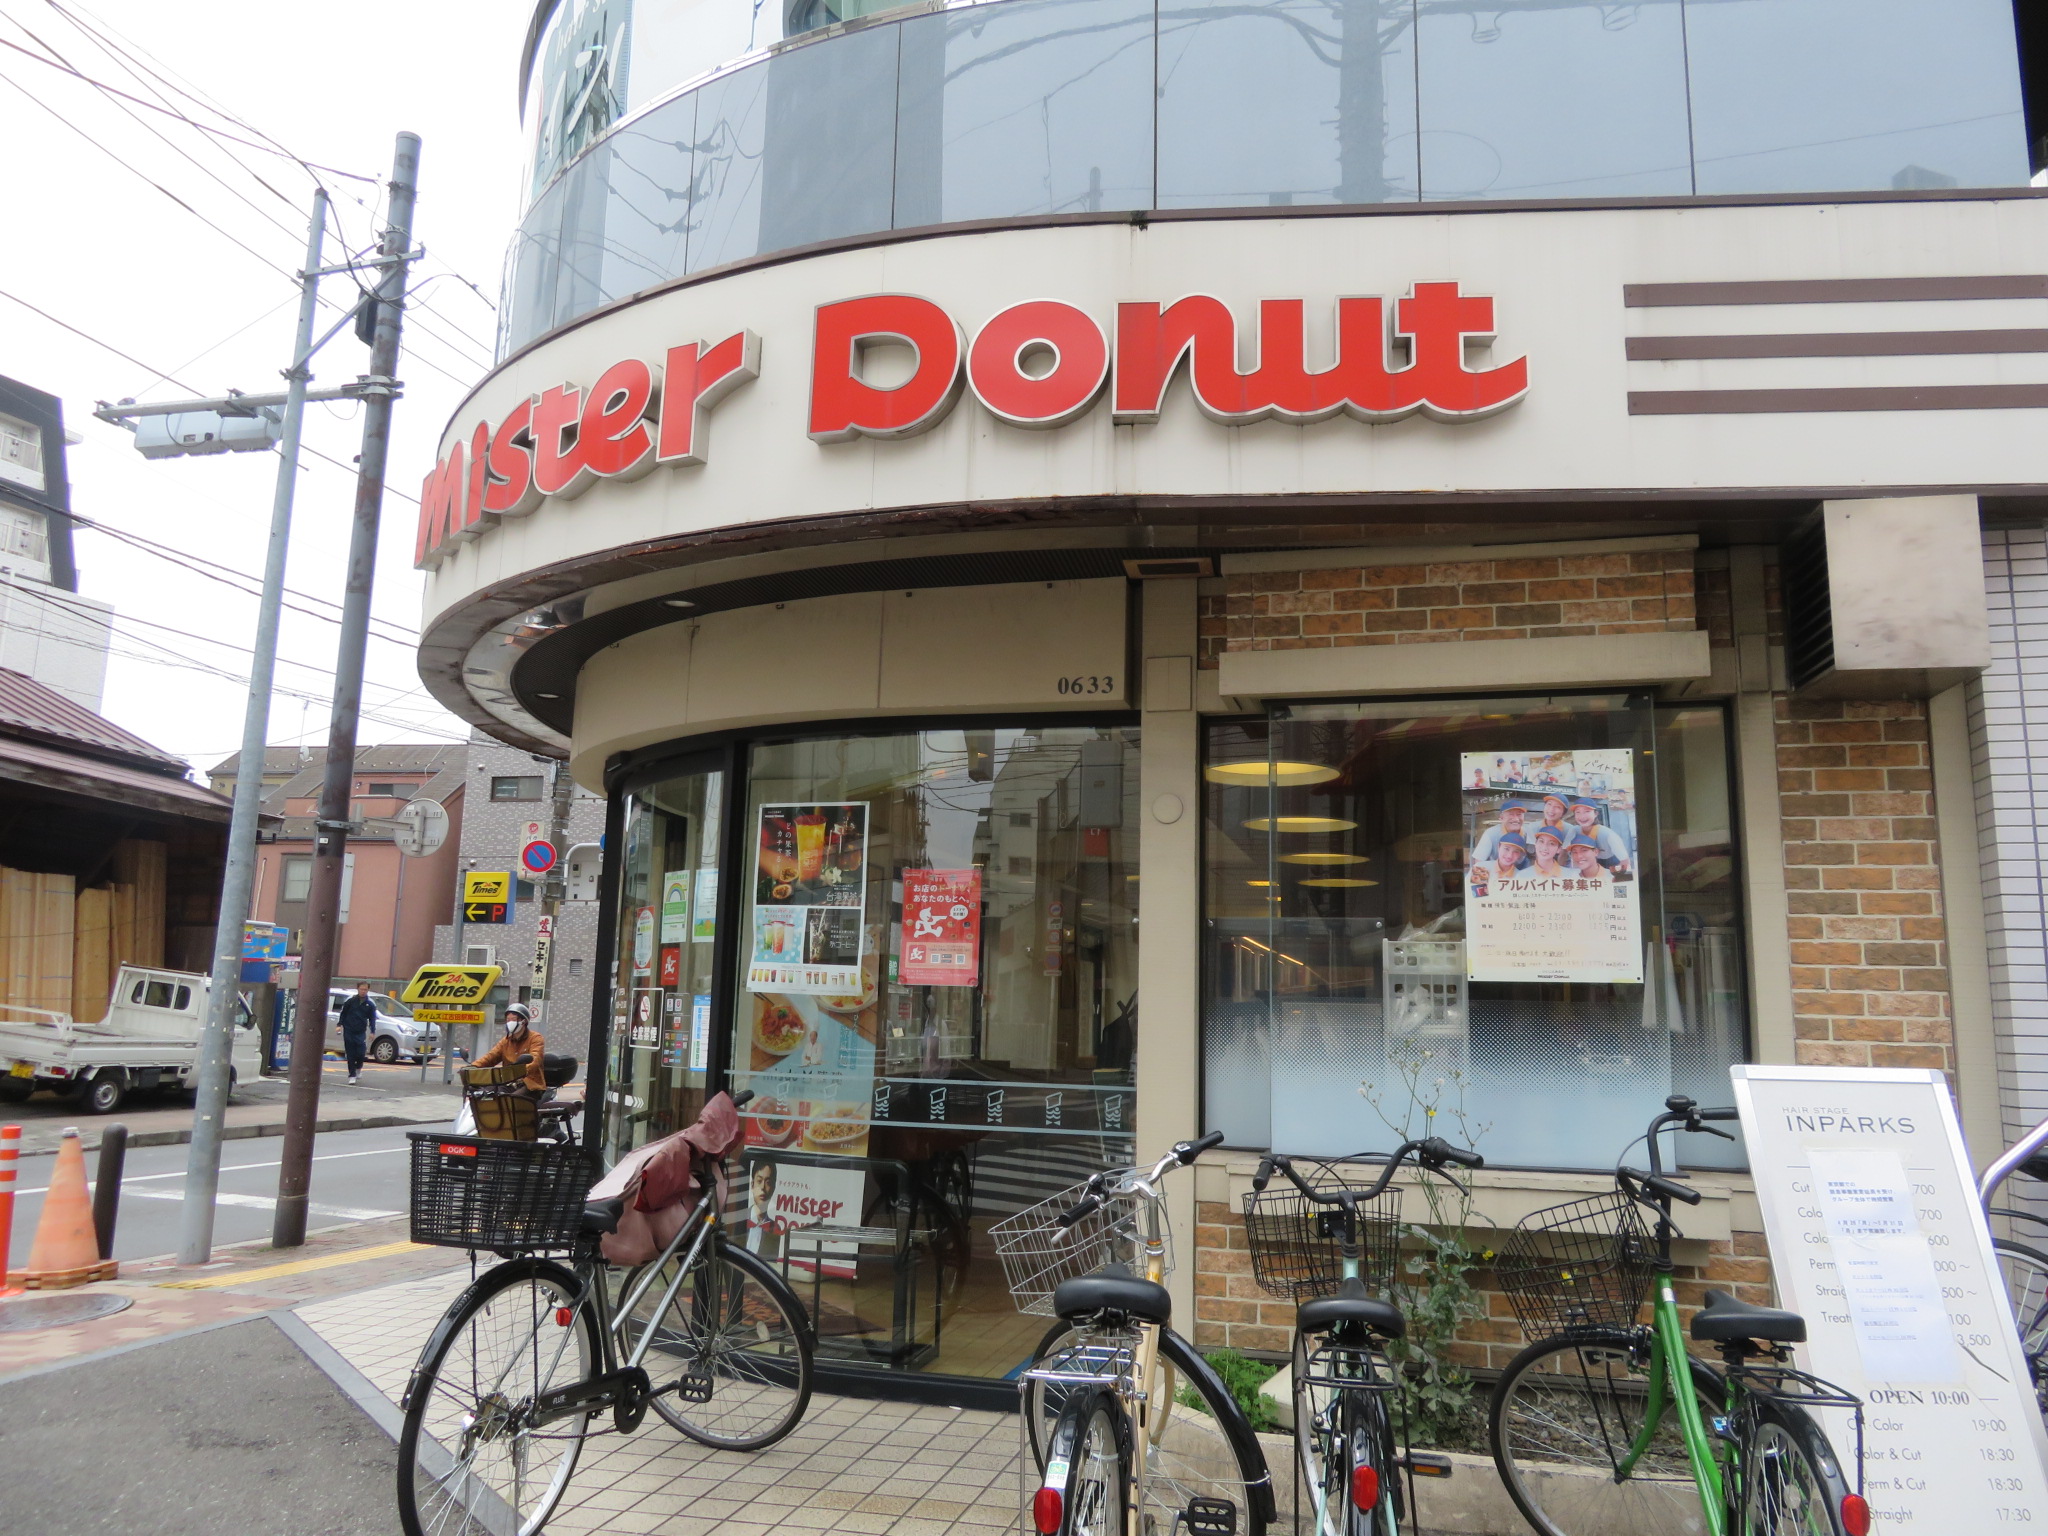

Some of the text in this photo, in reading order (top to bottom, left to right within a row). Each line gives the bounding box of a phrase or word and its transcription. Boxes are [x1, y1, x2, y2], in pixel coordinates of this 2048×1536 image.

[807, 280, 1530, 445] Donut
[1057, 675, 1114, 696] 0633
[472, 886, 498, 895] Times
[1498, 879, 1602, 892] アルバイト募集中
[913, 894, 970, 904] あなたのもとへ。
[492, 904, 505, 922] P
[445, 973, 464, 984] 24h
[418, 979, 480, 998] Times
[632, 1026, 658, 1042] 全席禁煙
[1782, 1106, 1849, 1115] HAIR STAGE
[1786, 1115, 1915, 1134] INPARKS
[447, 1146, 465, 1154] OGK
[1791, 1181, 1811, 1193] Cut
[1797, 1206, 1824, 1219] Colo
[1803, 1231, 1829, 1244] Colo
[1928, 1234, 1950, 1247] 600
[1809, 1258, 1837, 1270] Perm
[1934, 1260, 1957, 1272] 000
[1815, 1284, 1847, 1300] Straig
[1941, 1286, 1964, 1299] 500
[1821, 1311, 1852, 1324] Treat
[1949, 1313, 1971, 1326] 100
[1956, 1333, 1991, 1347] 3,500
[1870, 1389, 1970, 1405] OPEN 10:00
[1972, 1418, 2006, 1432] 19:00
[1889, 1448, 1899, 1461] &
[1901, 1447, 1922, 1461] Cut
[1979, 1448, 2014, 1462] 18:30
[1893, 1477, 1904, 1491] &
[1905, 1477, 1926, 1491] Cut
[1987, 1478, 2023, 1492] 18:30
[1869, 1505, 2031, 1524] Straight 17:30
